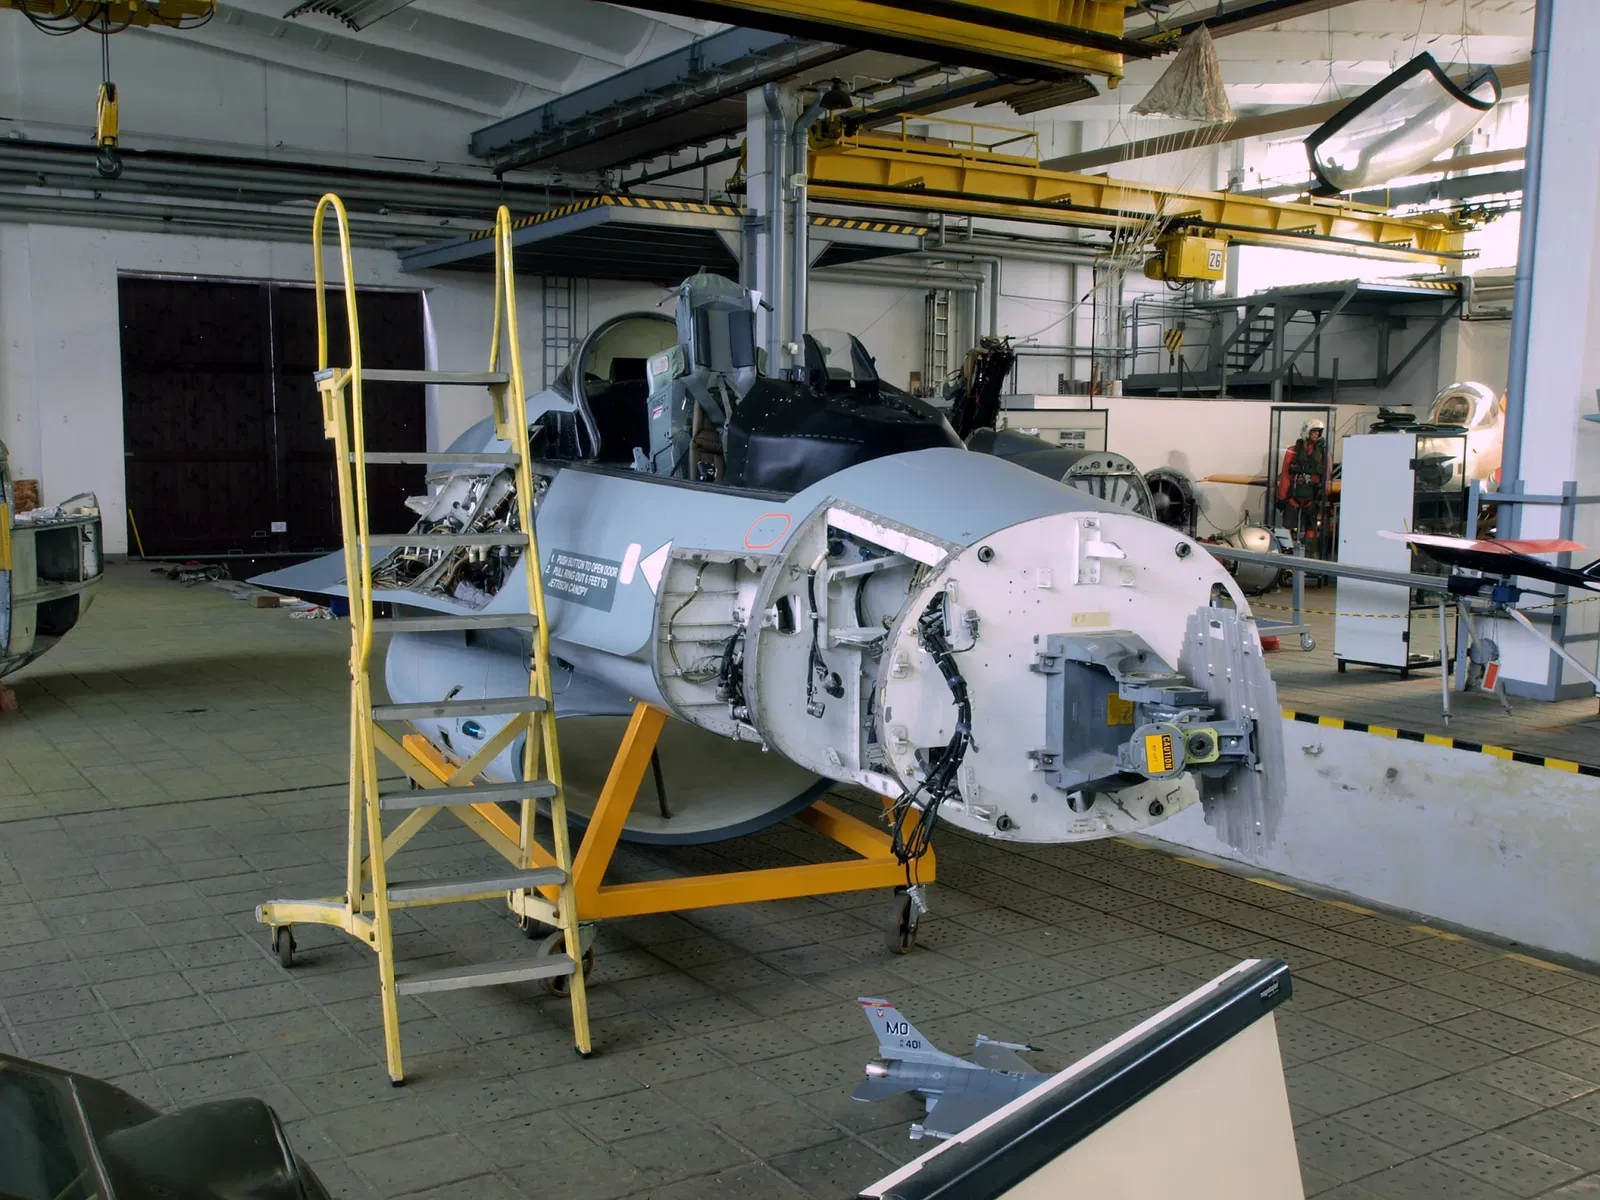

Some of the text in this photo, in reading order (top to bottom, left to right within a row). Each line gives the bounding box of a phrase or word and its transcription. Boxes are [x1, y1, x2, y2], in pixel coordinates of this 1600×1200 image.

[1210, 253, 1221, 268] 26
[556, 554, 568, 565] PUSH
[568, 557, 585, 569] BUTTON
[584, 561, 592, 571] TO
[592, 562, 603, 574] OPEN
[604, 565, 618, 577] DOOR
[552, 566, 564, 577] PULL
[563, 569, 576, 580] RING
[575, 572, 585, 584] OUT
[588, 575, 600, 587] FEET
[600, 578, 608, 588] TO
[548, 578, 588, 596] JETTISON CANOPY
[1163, 737, 1172, 769] CAUTION
[886, 1021, 910, 1036] MO
[906, 1040, 921, 1049] 401
